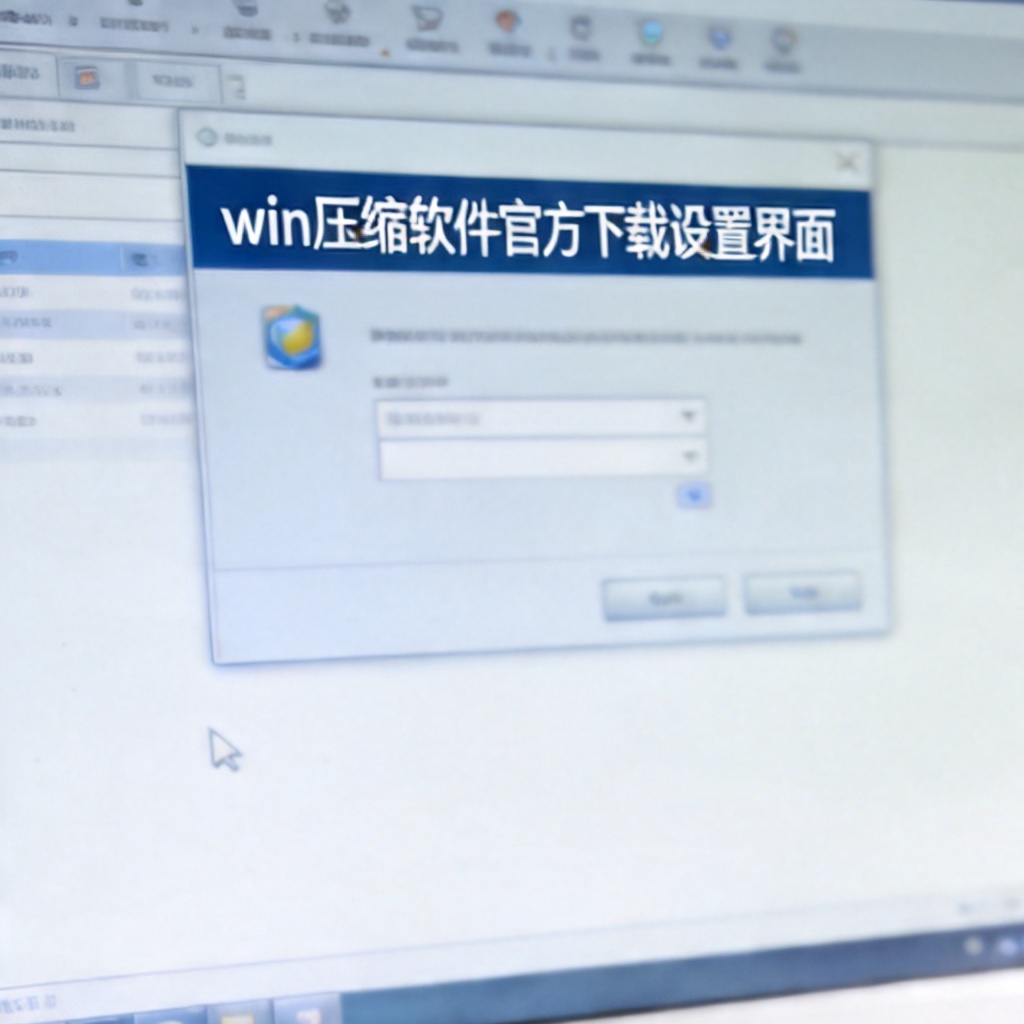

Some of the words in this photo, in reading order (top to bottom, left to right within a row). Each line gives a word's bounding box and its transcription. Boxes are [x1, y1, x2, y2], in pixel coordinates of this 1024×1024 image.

[220, 194, 836, 262] win压缩软件官方下载设置界面
